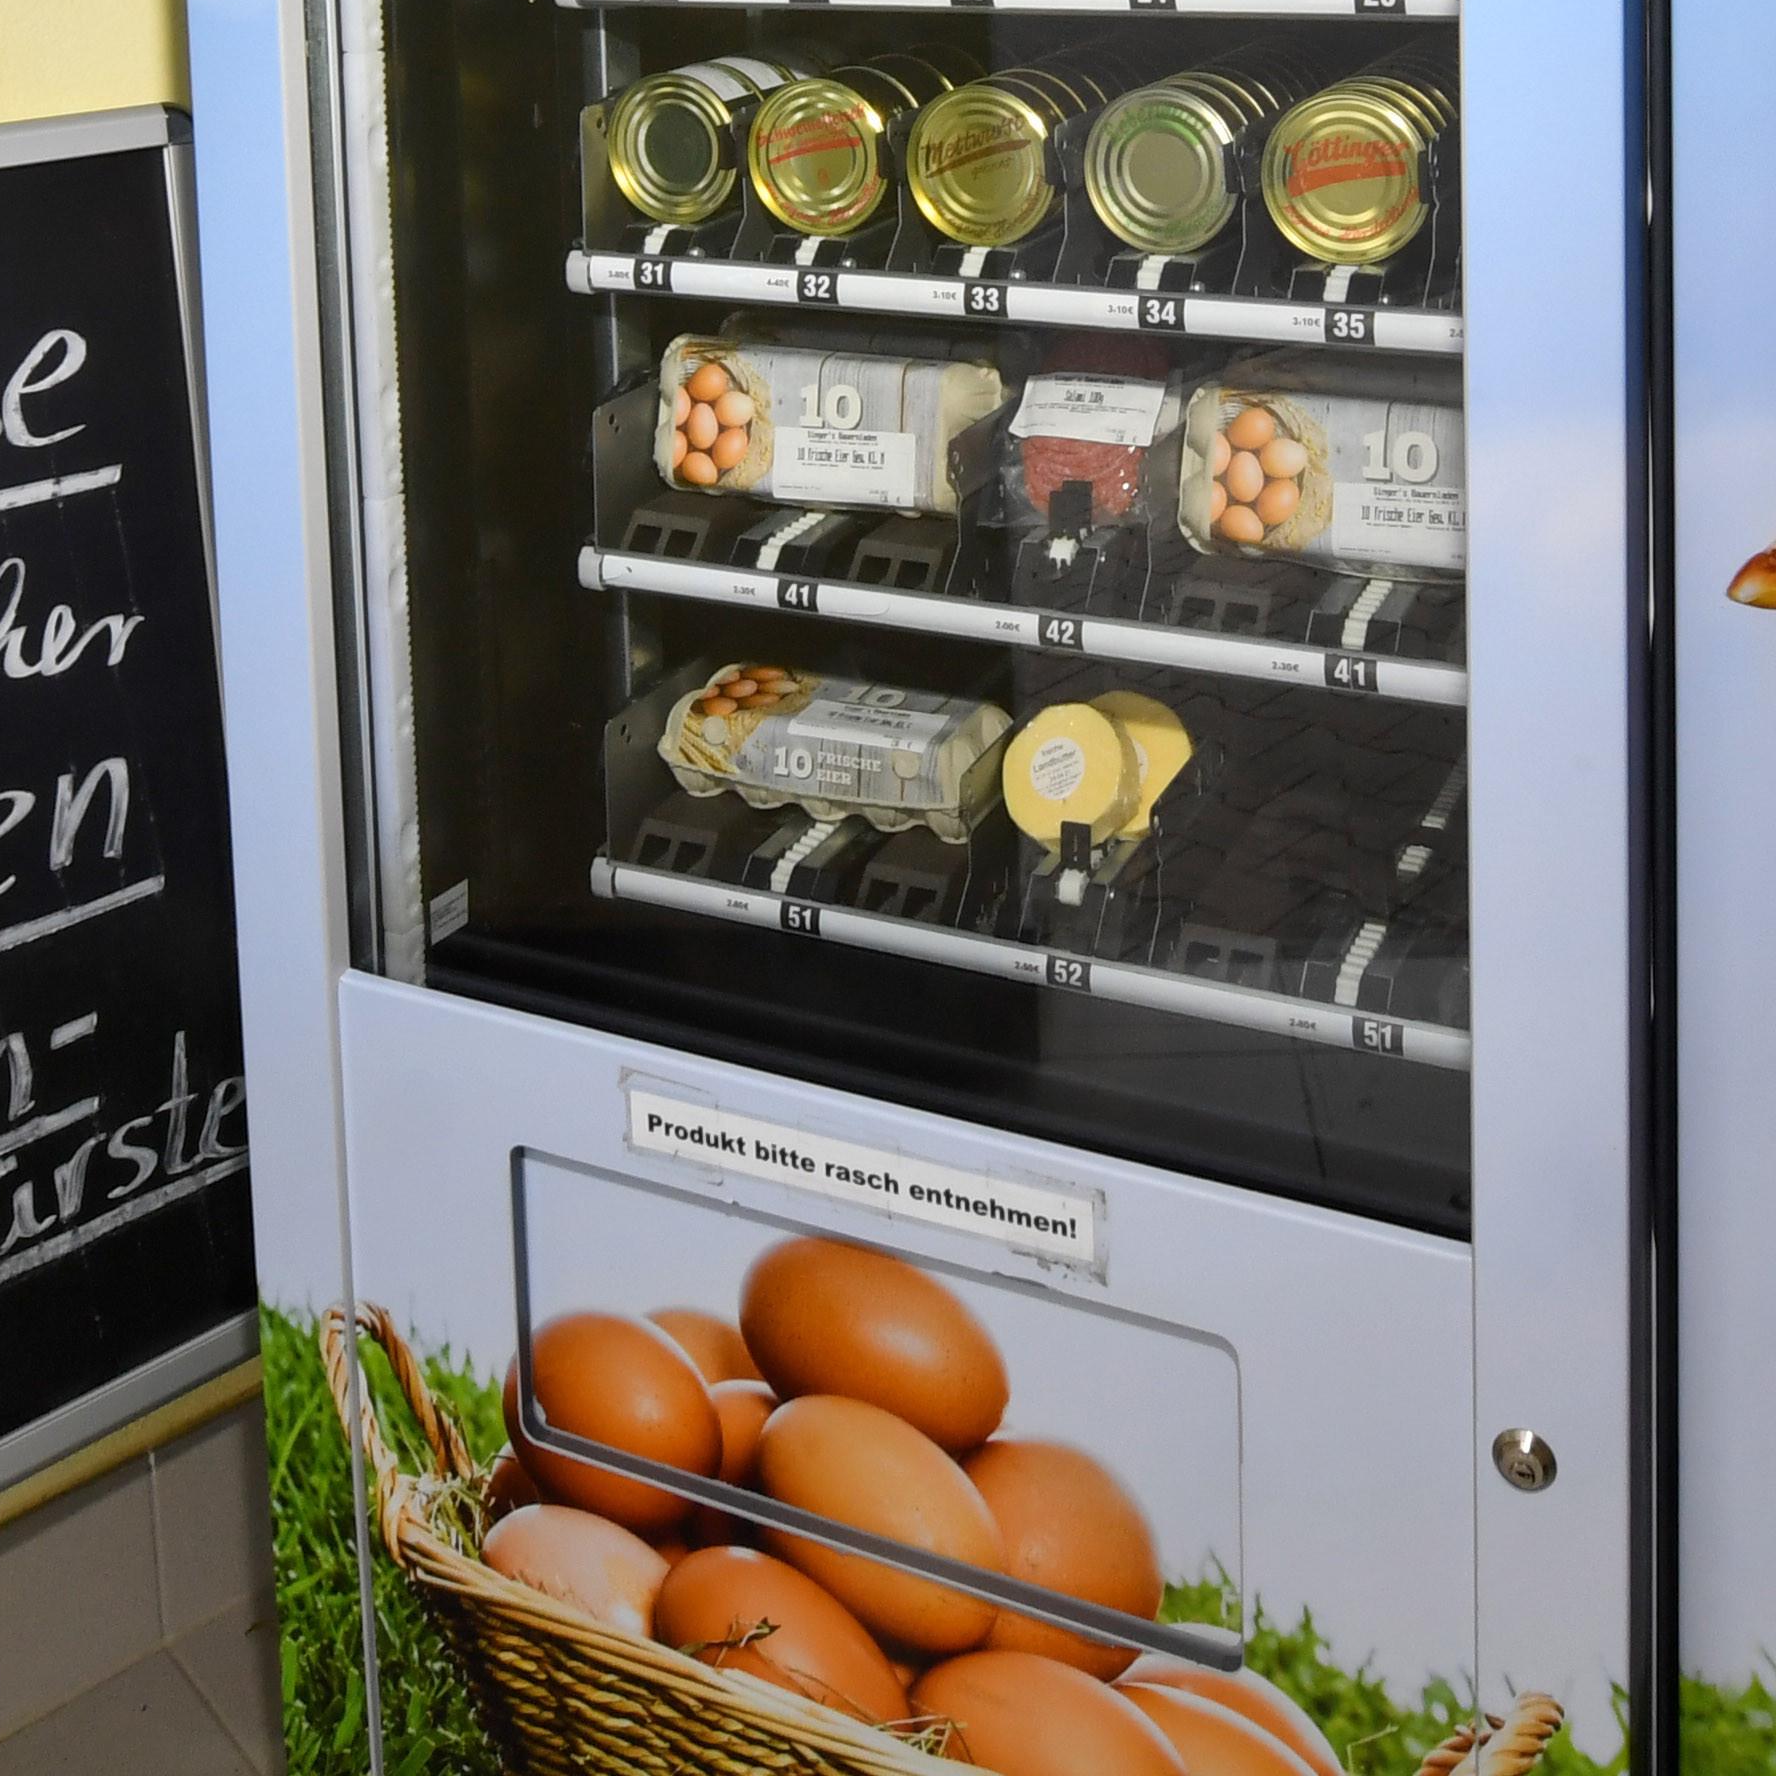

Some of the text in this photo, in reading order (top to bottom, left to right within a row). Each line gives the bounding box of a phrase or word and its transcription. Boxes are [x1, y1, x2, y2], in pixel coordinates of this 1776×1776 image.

[640, 262, 664, 286] 31
[803, 275, 831, 299] 32
[971, 286, 1000, 312] 33
[1146, 299, 1176, 325] 34
[1332, 312, 1365, 339] 35
[799, 384, 863, 430] 10
[1361, 429, 1439, 484] 10
[785, 583, 810, 607] 41
[1046, 619, 1075, 645] 42
[1334, 658, 1365, 687] 41
[840, 685, 907, 709] 10
[773, 745, 882, 780] 10 FRISCHE
[816, 768, 852, 786] EIER
[788, 905, 813, 931] 51
[1054, 959, 1083, 987] 52
[1363, 1021, 1393, 1050] 51
[647, 1113, 1077, 1239] Produkt bitte rasch entnehmen!
